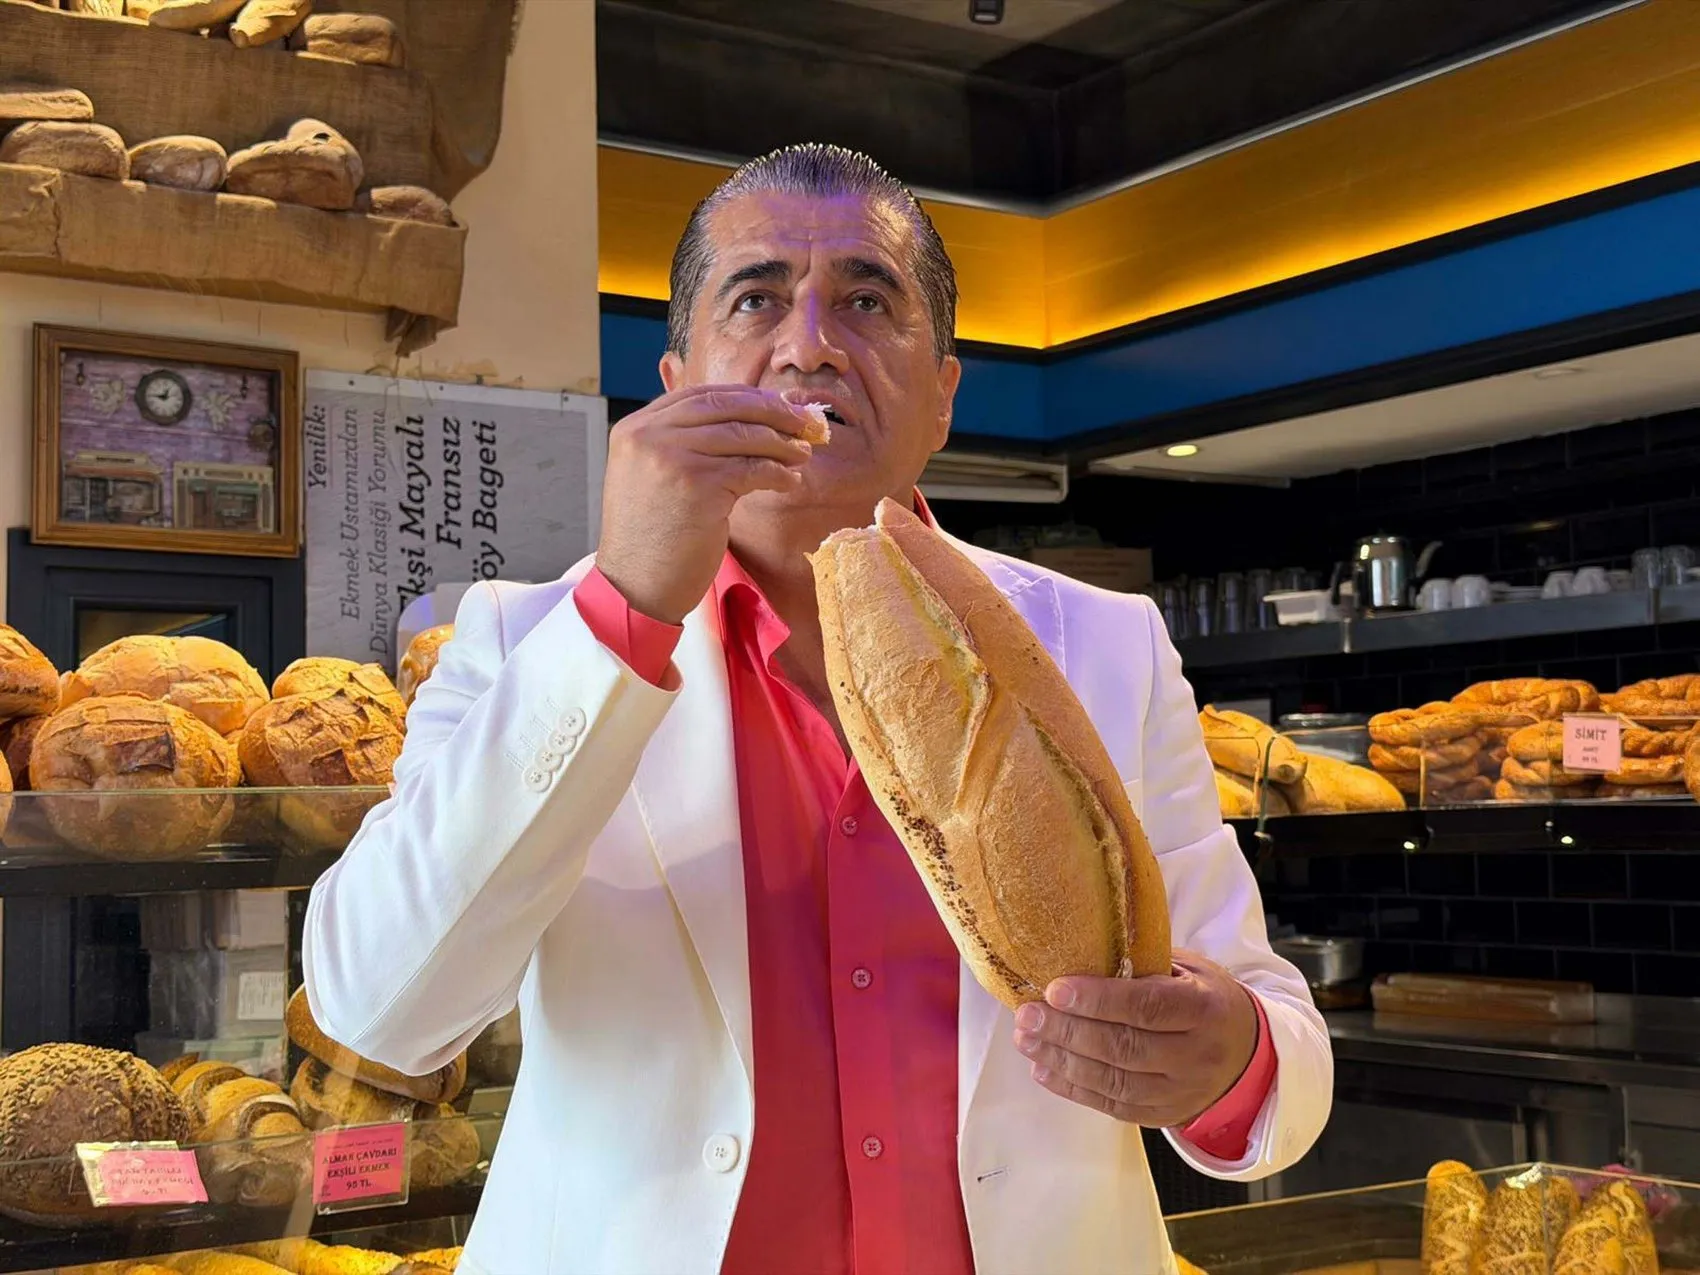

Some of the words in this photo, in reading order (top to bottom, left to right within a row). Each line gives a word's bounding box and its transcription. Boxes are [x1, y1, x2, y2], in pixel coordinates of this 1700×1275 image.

[305, 405, 327, 489] Yenilik:
[338, 408, 360, 541] Ustamızdan
[368, 409, 387, 493] Yorumu
[395, 415, 432, 540] Mayalı
[436, 417, 462, 549] Fransız
[472, 420, 504, 534] Bageti
[367, 501, 391, 577] Klasiği
[472, 541, 505, 581] öy
[339, 547, 360, 620] Ekmek
[369, 582, 392, 654] Dünya
